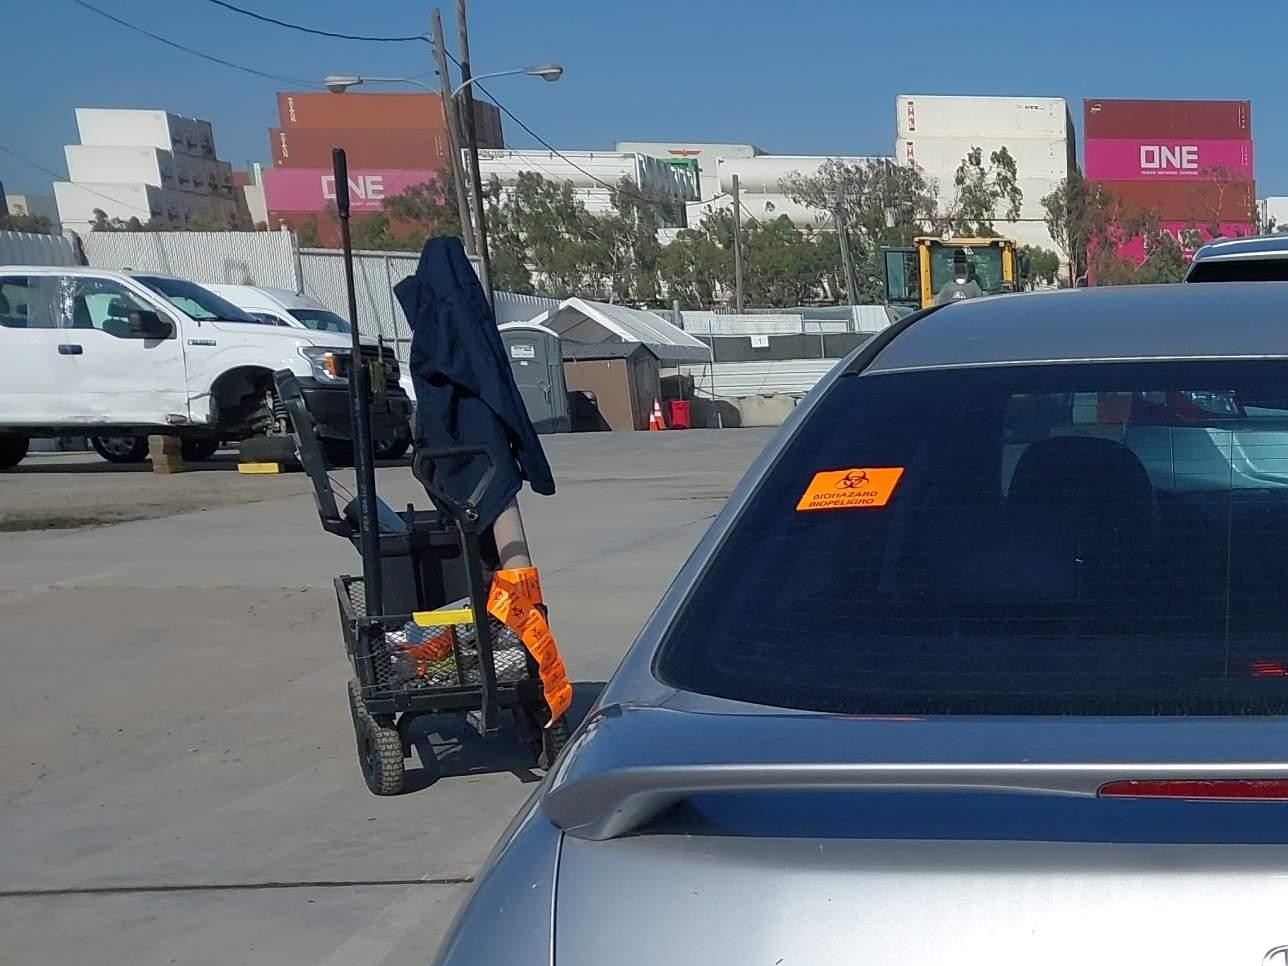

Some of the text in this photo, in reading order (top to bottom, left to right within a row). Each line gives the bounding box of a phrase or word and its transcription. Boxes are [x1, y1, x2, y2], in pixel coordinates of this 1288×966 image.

[1140, 145, 1198, 169] ONE
[813, 491, 878, 500] BIOHAZARD
[808, 498, 874, 507] BIOPELIGRO
